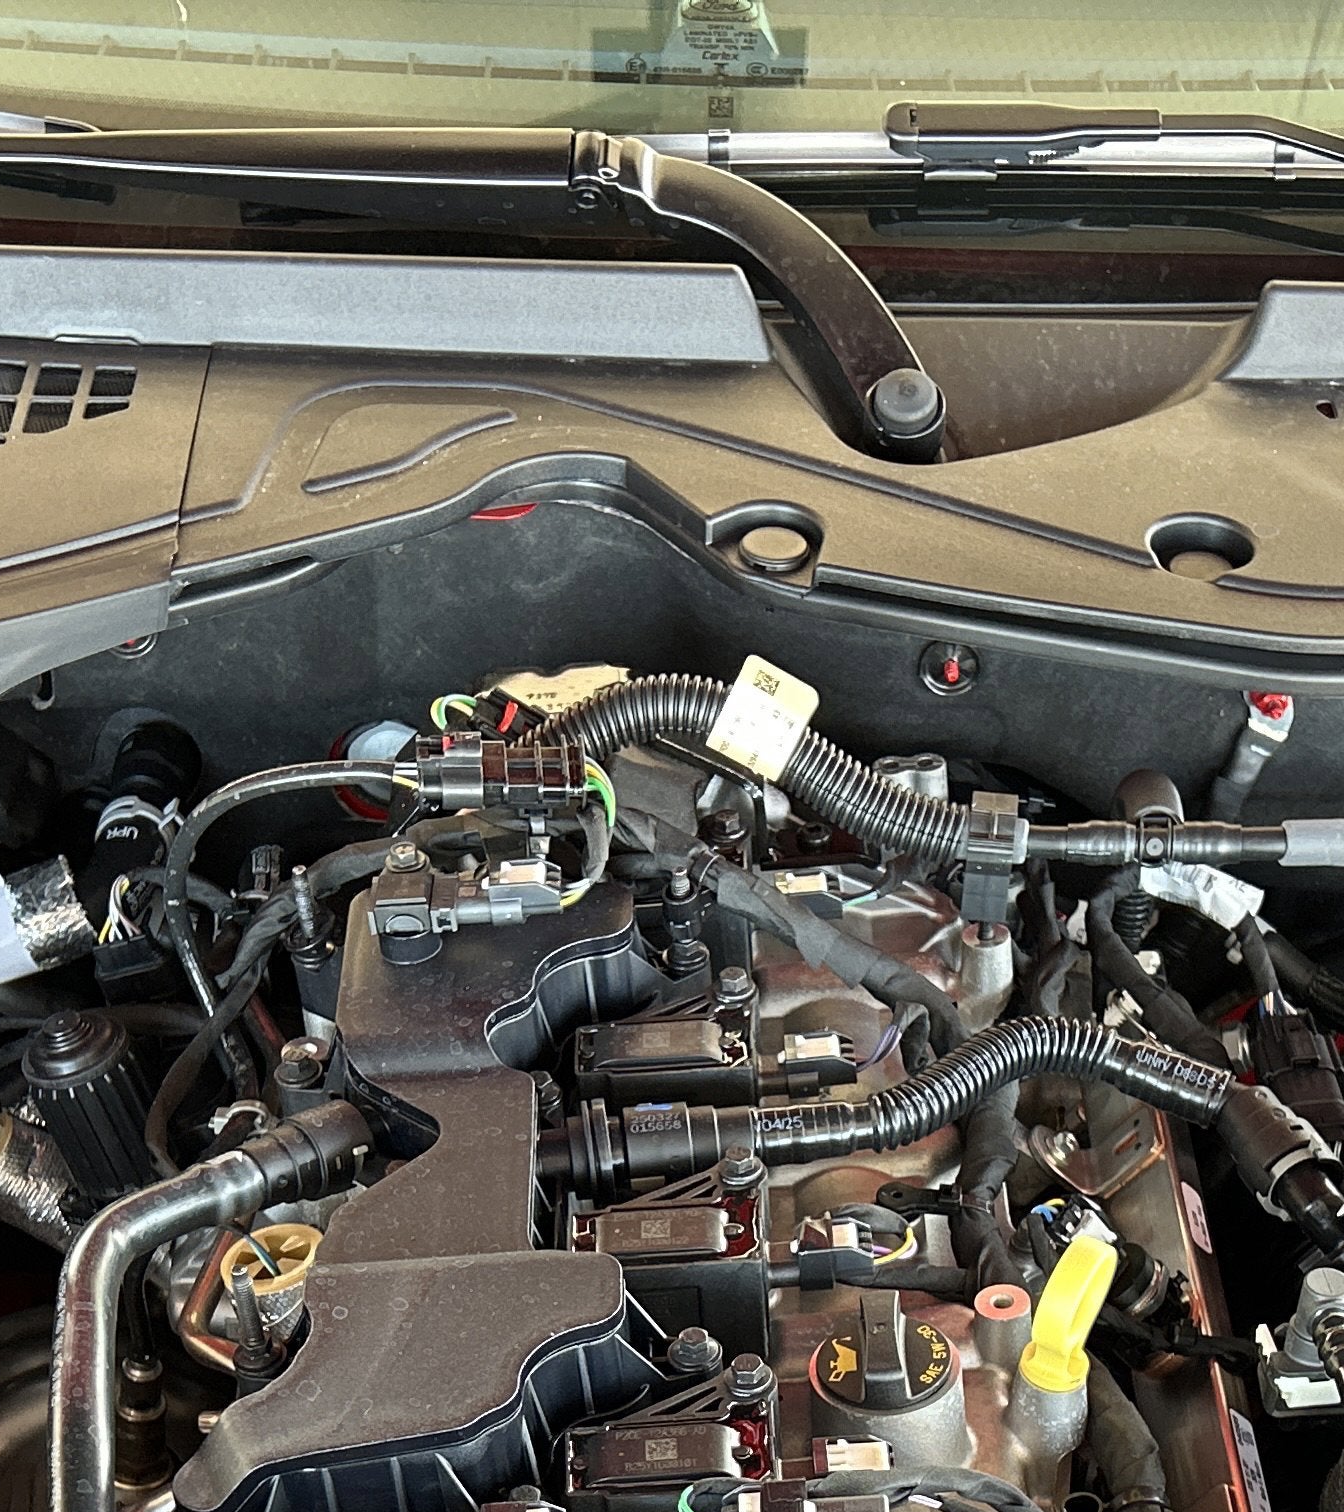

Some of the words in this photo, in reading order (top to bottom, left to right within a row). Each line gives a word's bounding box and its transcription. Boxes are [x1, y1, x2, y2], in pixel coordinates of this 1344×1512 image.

[106, 825, 139, 841] UPR
[629, 1120, 682, 1134] 015658
[916, 1324, 948, 1360] 5W-30
[919, 1362, 944, 1384] SAE
